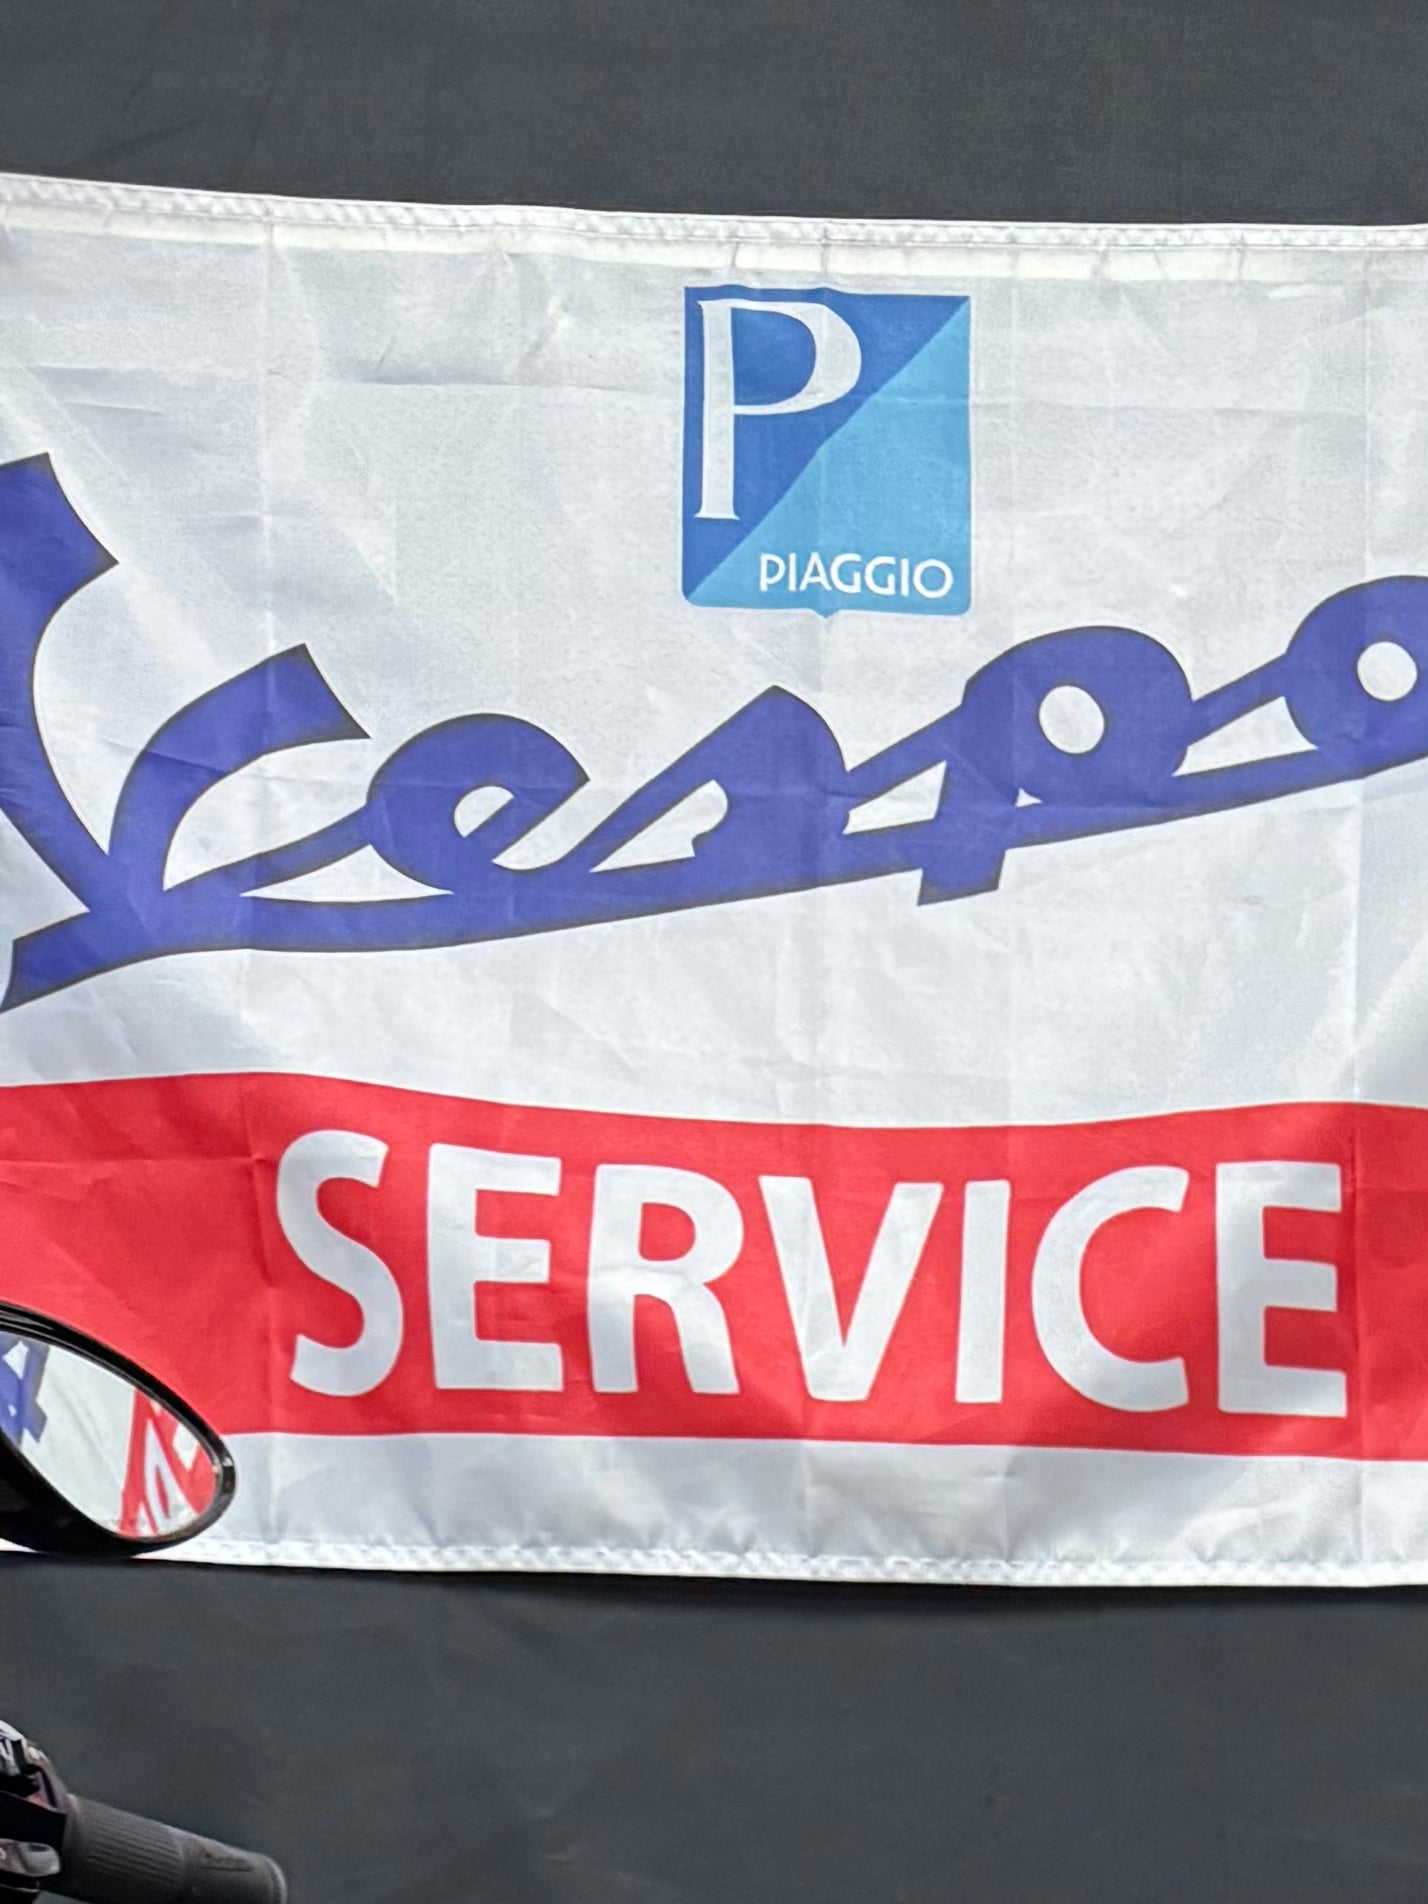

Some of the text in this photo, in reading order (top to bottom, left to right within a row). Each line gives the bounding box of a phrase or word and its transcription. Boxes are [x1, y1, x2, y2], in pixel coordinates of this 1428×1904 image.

[694, 298, 862, 520] P
[759, 552, 955, 599] PIAGGIO
[274, 1129, 1348, 1418] SERVICE
